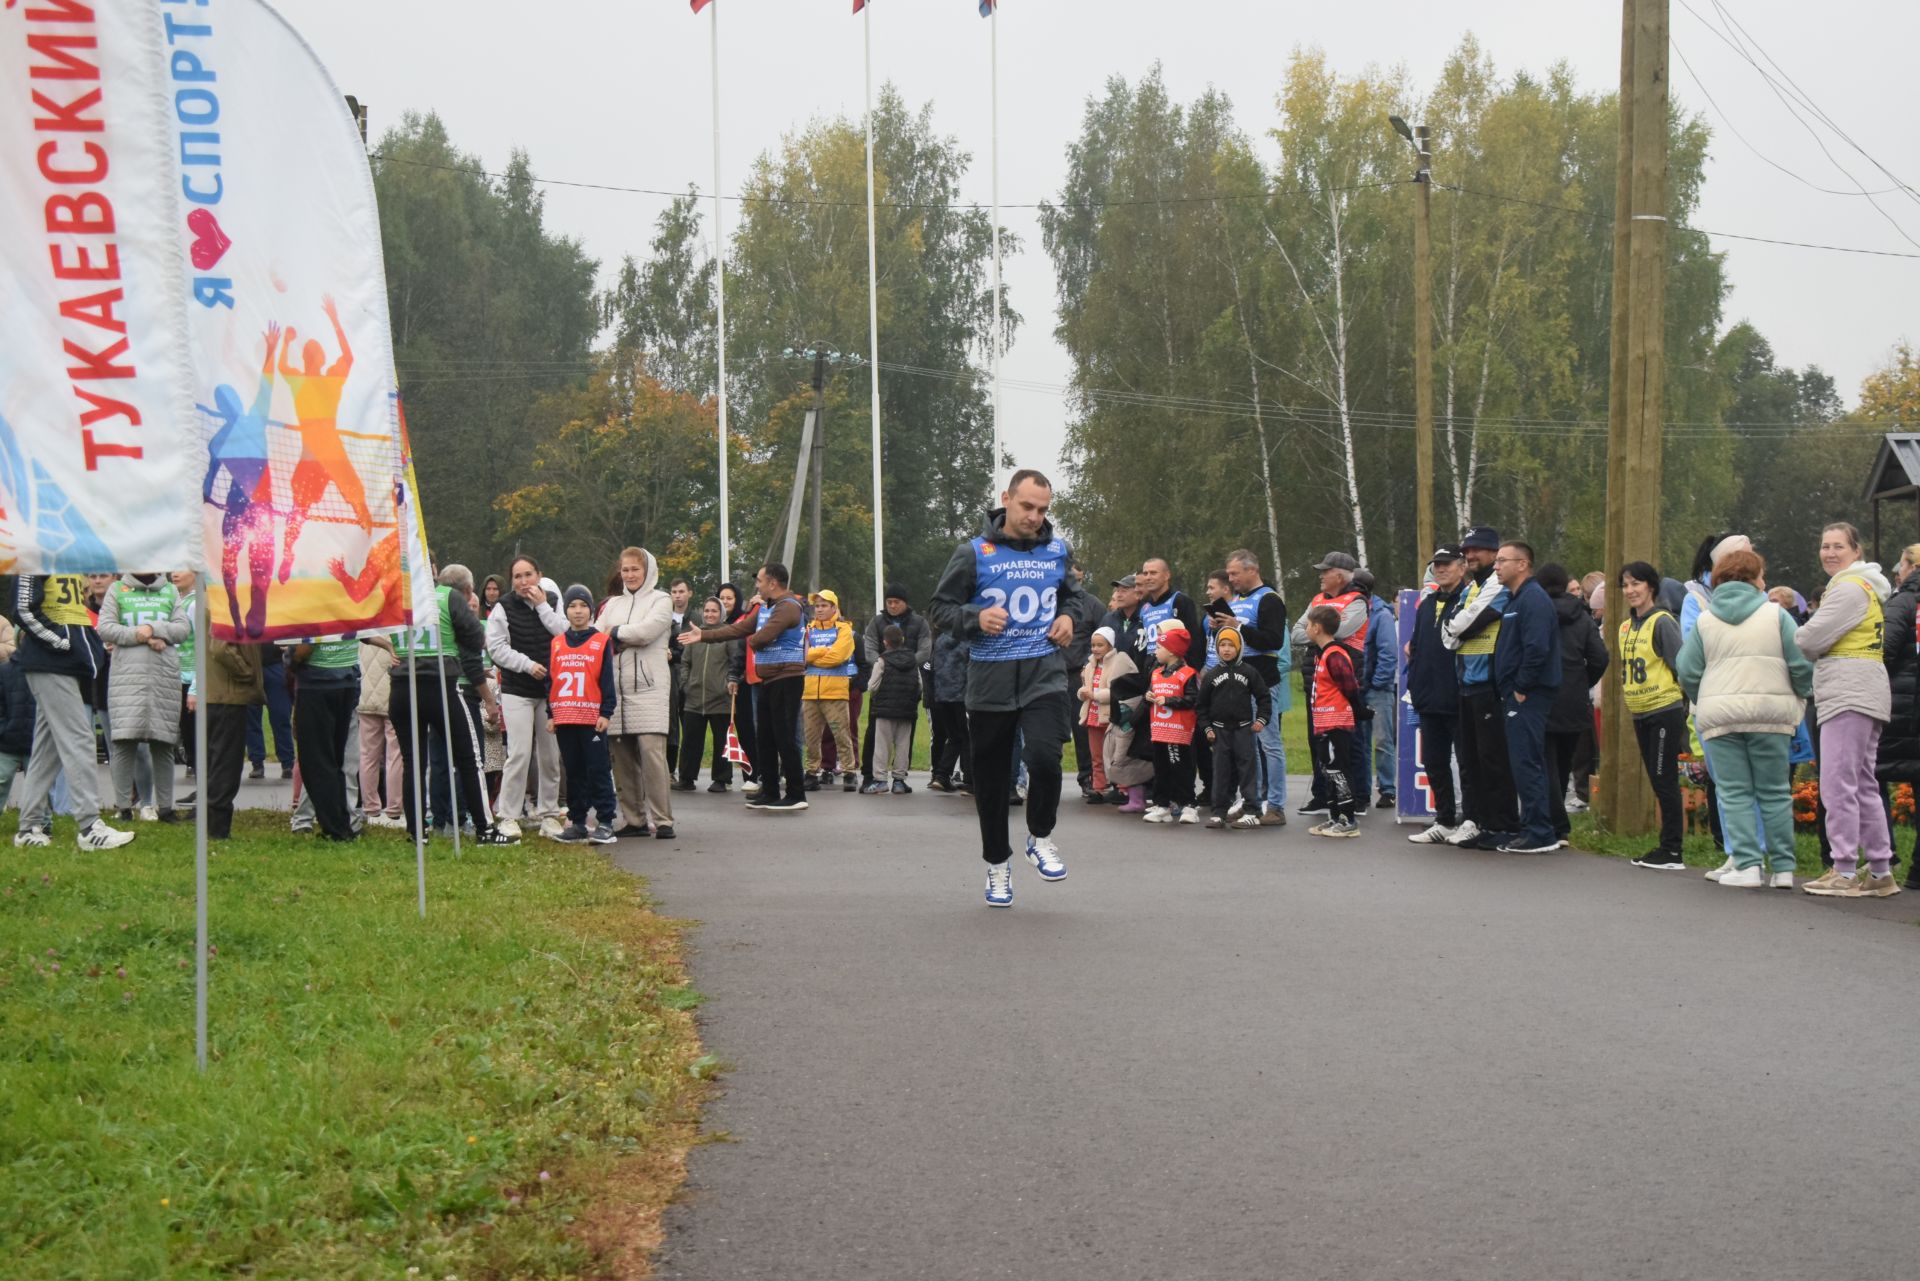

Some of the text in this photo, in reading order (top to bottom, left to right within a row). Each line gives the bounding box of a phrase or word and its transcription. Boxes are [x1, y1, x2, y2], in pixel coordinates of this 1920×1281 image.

[193, 277, 235, 310] Я
[989, 560, 1057, 573] ТУКАЕВСКИЙ
[1006, 568, 1044, 579] РАЙОН
[56, 577, 84, 605] 31
[981, 586, 1057, 623] 209
[558, 671, 585, 697] 21
